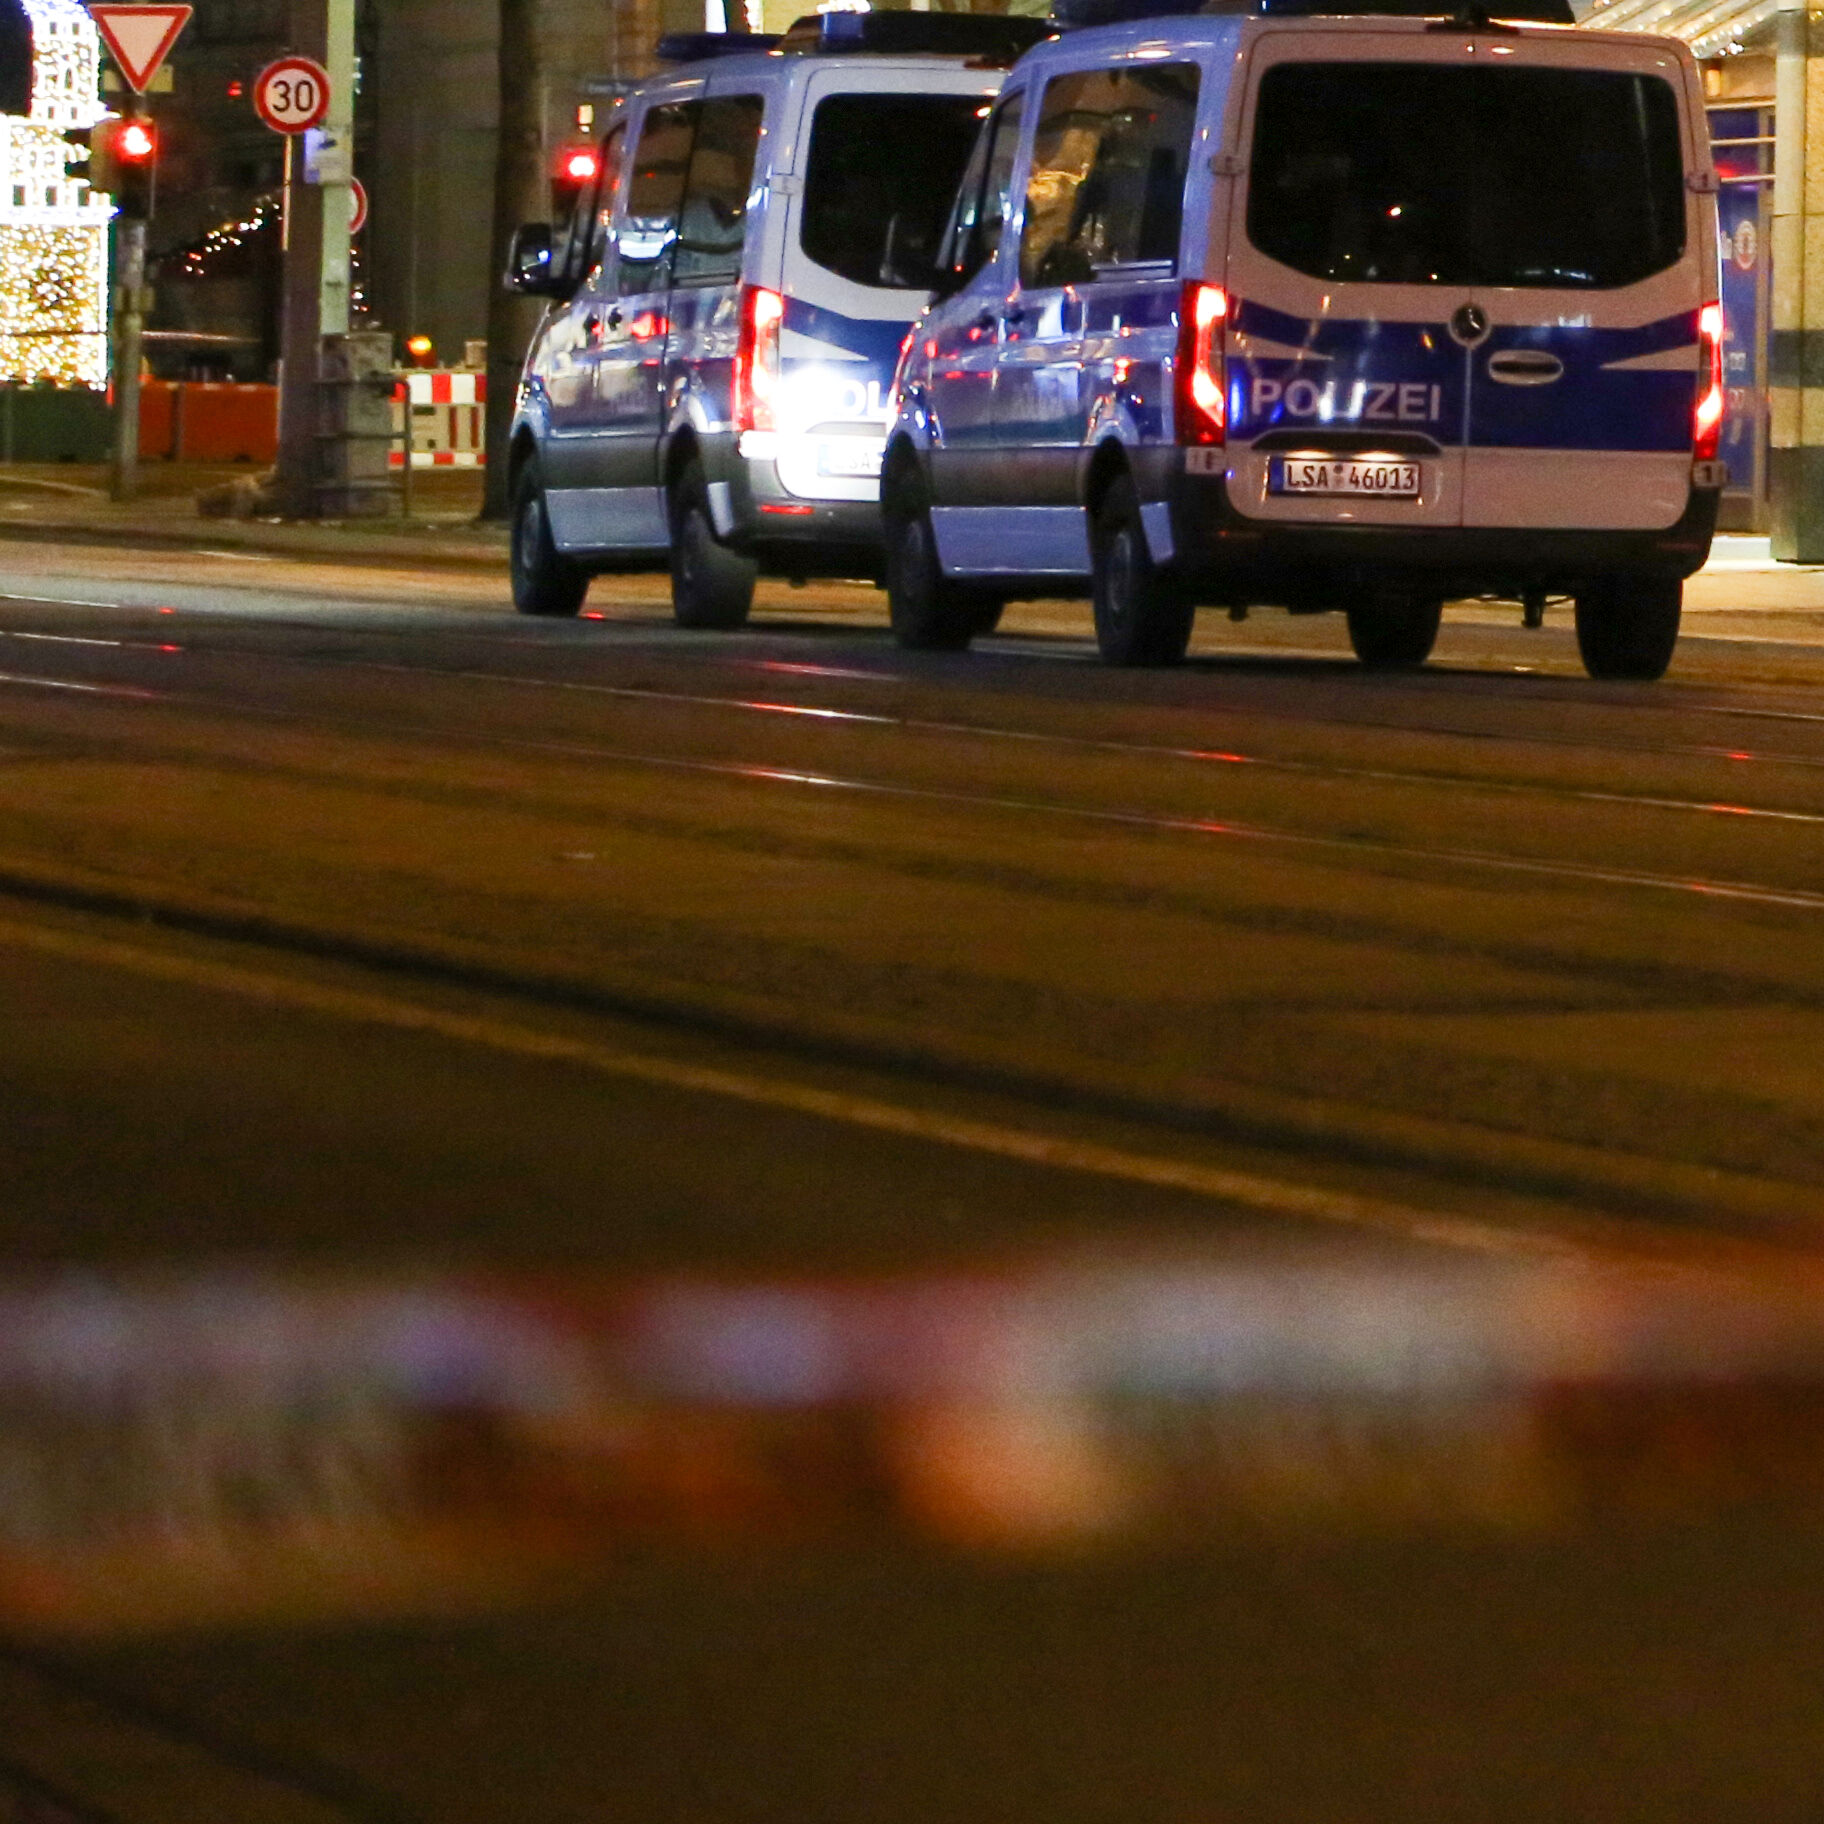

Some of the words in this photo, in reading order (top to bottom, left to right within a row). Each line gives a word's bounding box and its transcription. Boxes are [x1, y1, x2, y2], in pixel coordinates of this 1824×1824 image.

[272, 80, 315, 112] 30
[1251, 379, 1441, 421] POLIZEI
[1287, 464, 1329, 488] LSA
[1349, 467, 1414, 490] 46013
